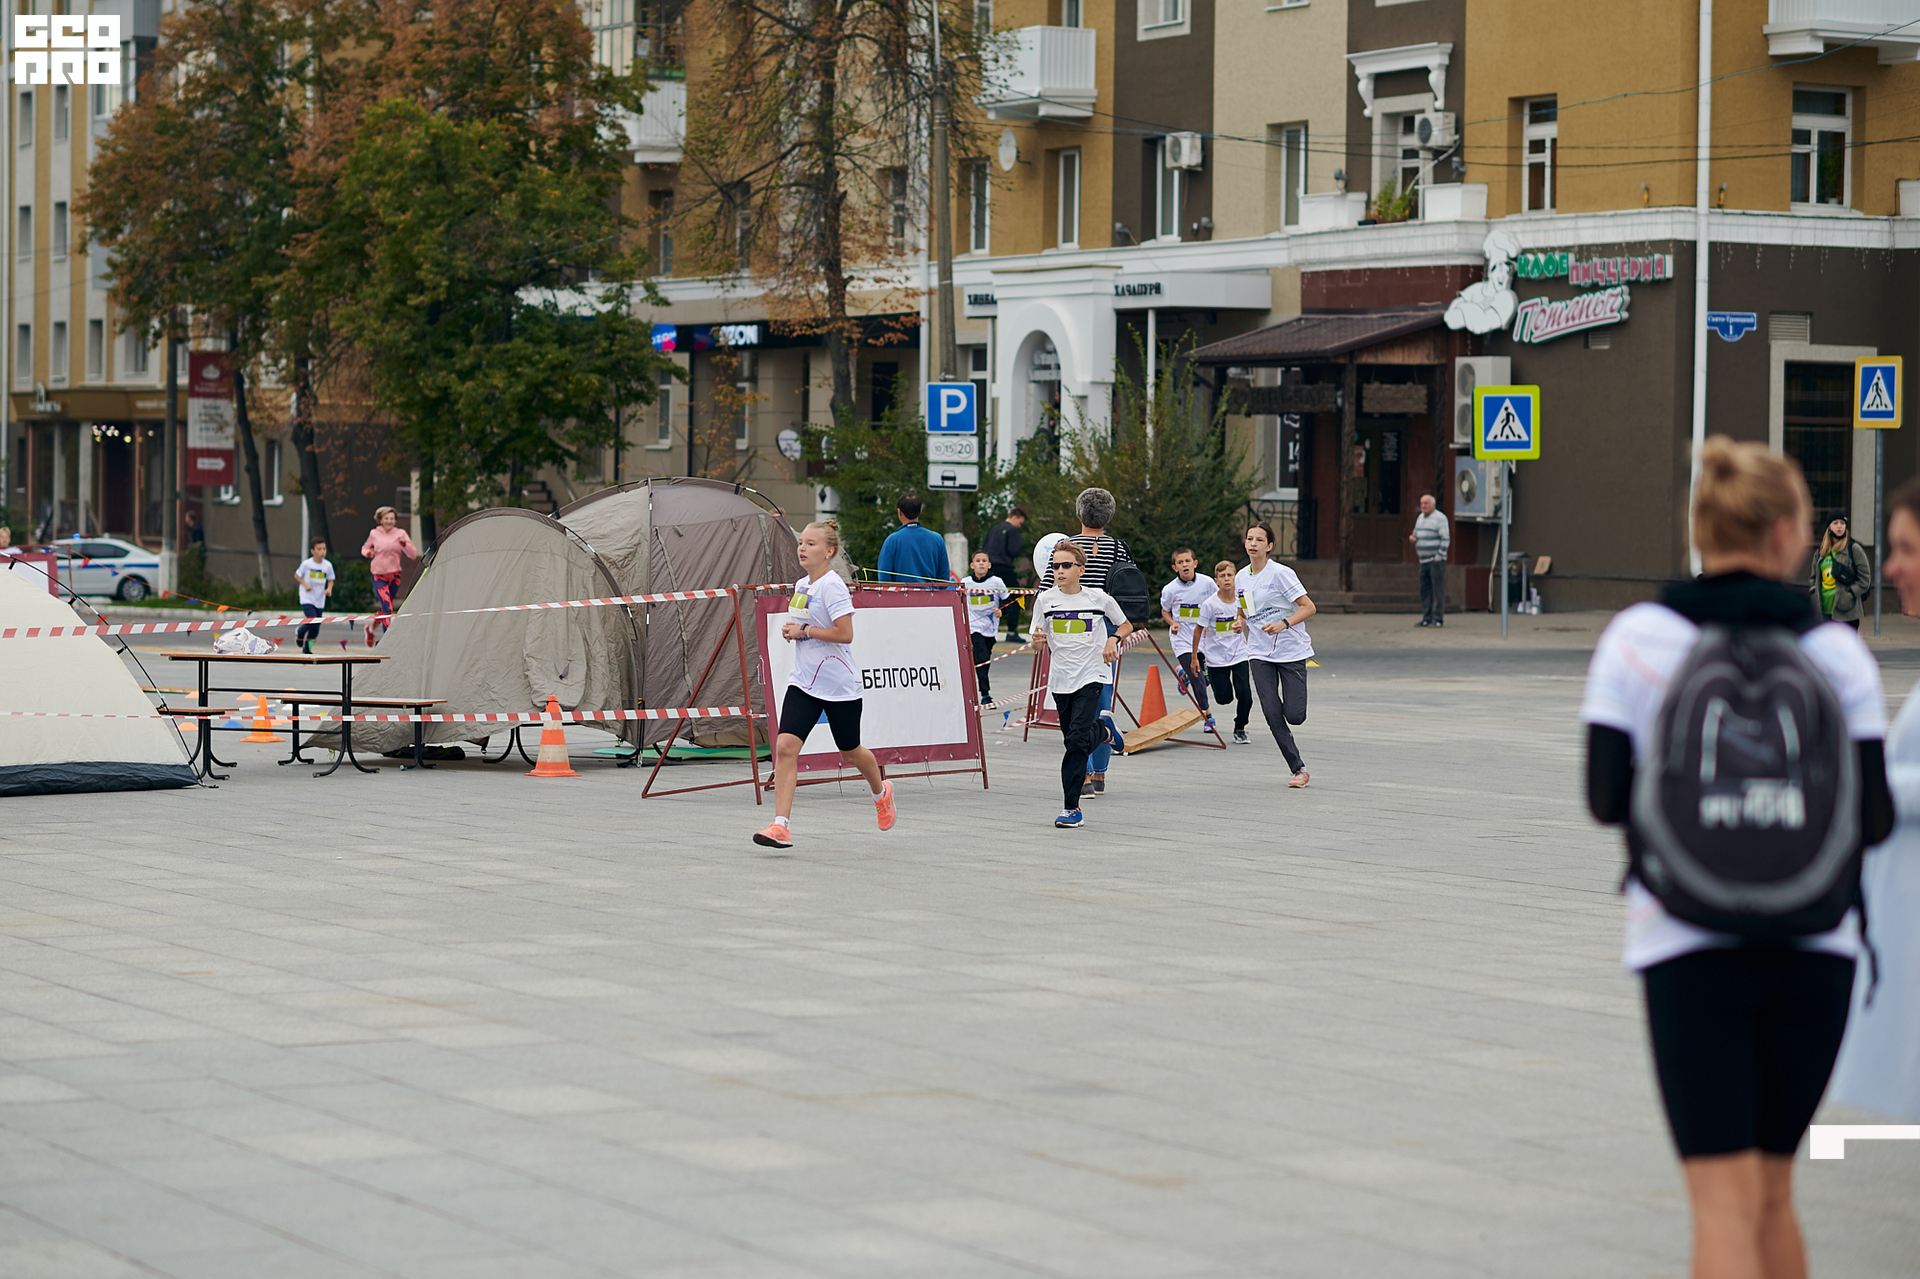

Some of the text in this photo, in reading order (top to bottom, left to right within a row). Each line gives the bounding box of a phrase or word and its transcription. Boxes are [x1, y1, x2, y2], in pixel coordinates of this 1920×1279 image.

[1517, 252, 1671, 287] КАФЕ ПИЦЦЕРИЯ
[1114, 282, 1162, 297] ХАЧАПУРИ
[940, 388, 967, 427] P
[945, 444, 955, 452] 15
[958, 443, 971, 454] 20
[1188, 608, 1194, 617] 1
[1064, 619, 1071, 633] 1
[1225, 621, 1230, 631] 1
[861, 666, 941, 692] БЕЛГОРОД
